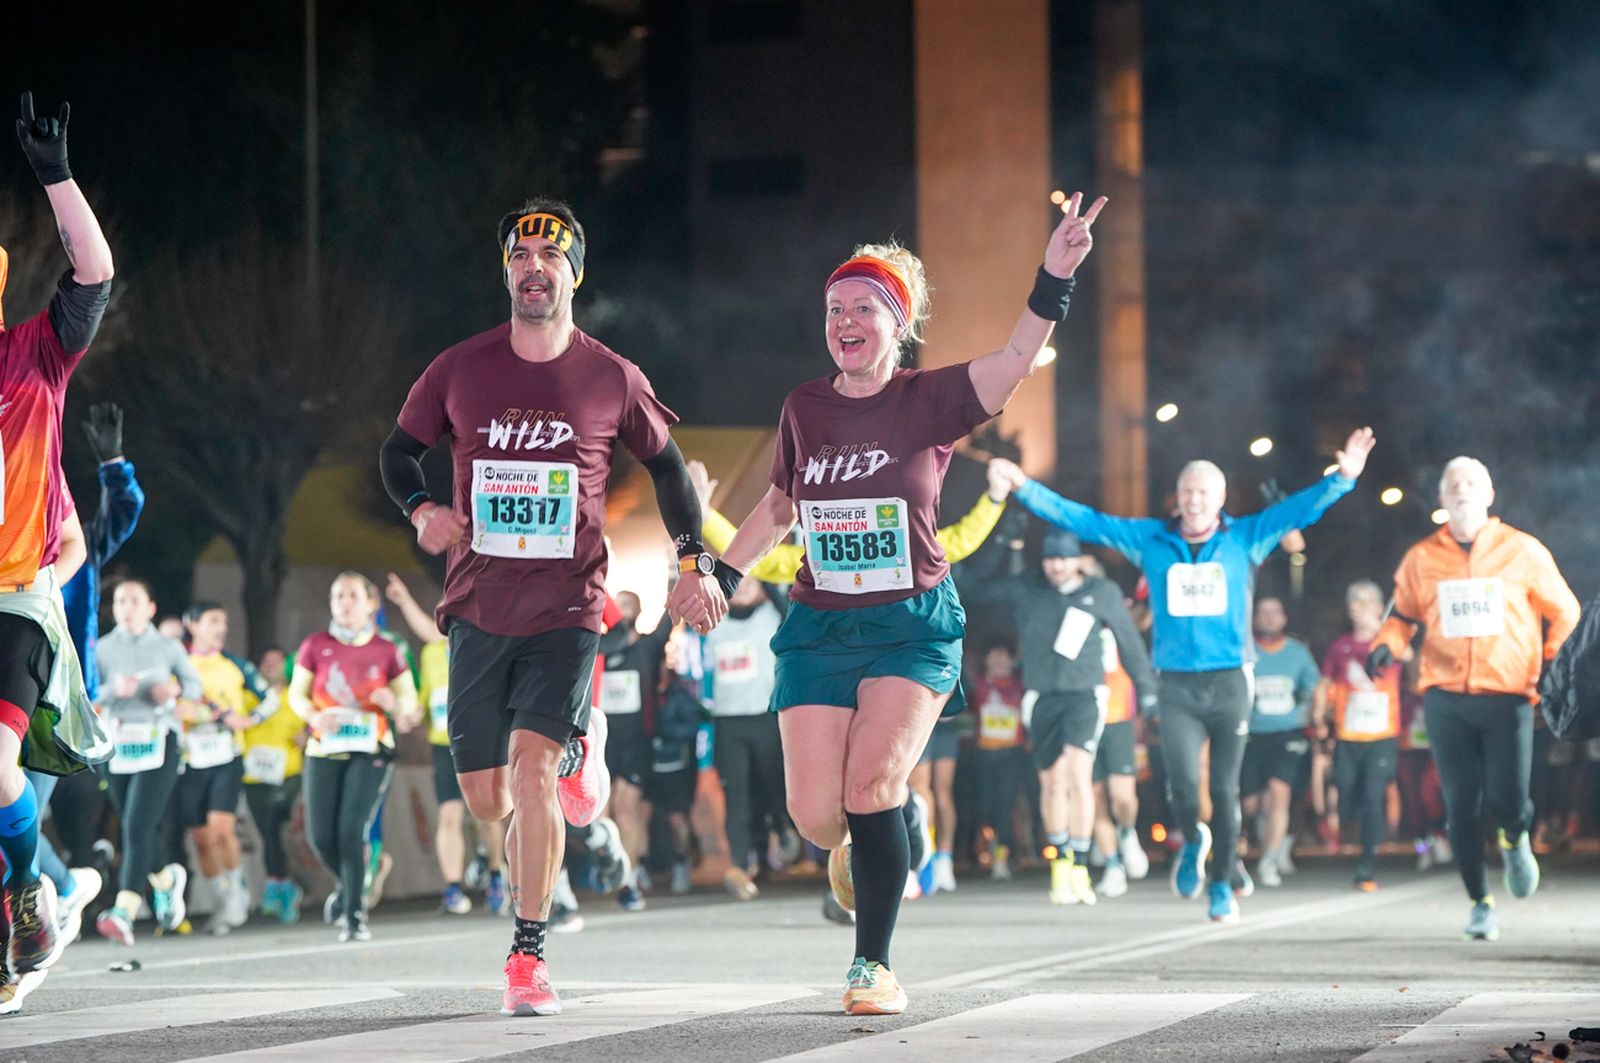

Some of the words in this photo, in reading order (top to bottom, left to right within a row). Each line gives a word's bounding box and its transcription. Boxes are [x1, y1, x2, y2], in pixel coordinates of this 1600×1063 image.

[499, 408, 565, 432] RUN
[487, 418, 574, 450] WILD
[815, 441, 879, 464] RUN
[496, 472, 525, 482] NOCHE
[526, 473, 539, 483] DE
[803, 449, 890, 485] WILD
[483, 482, 504, 493] SAN
[504, 482, 539, 495] ANTÓN
[488, 495, 561, 525] 13317
[824, 511, 853, 520] NOCHE
[854, 510, 867, 519] DE
[815, 522, 835, 532] SAN
[835, 519, 868, 532] ANTÓN
[816, 530, 897, 562] 13583
